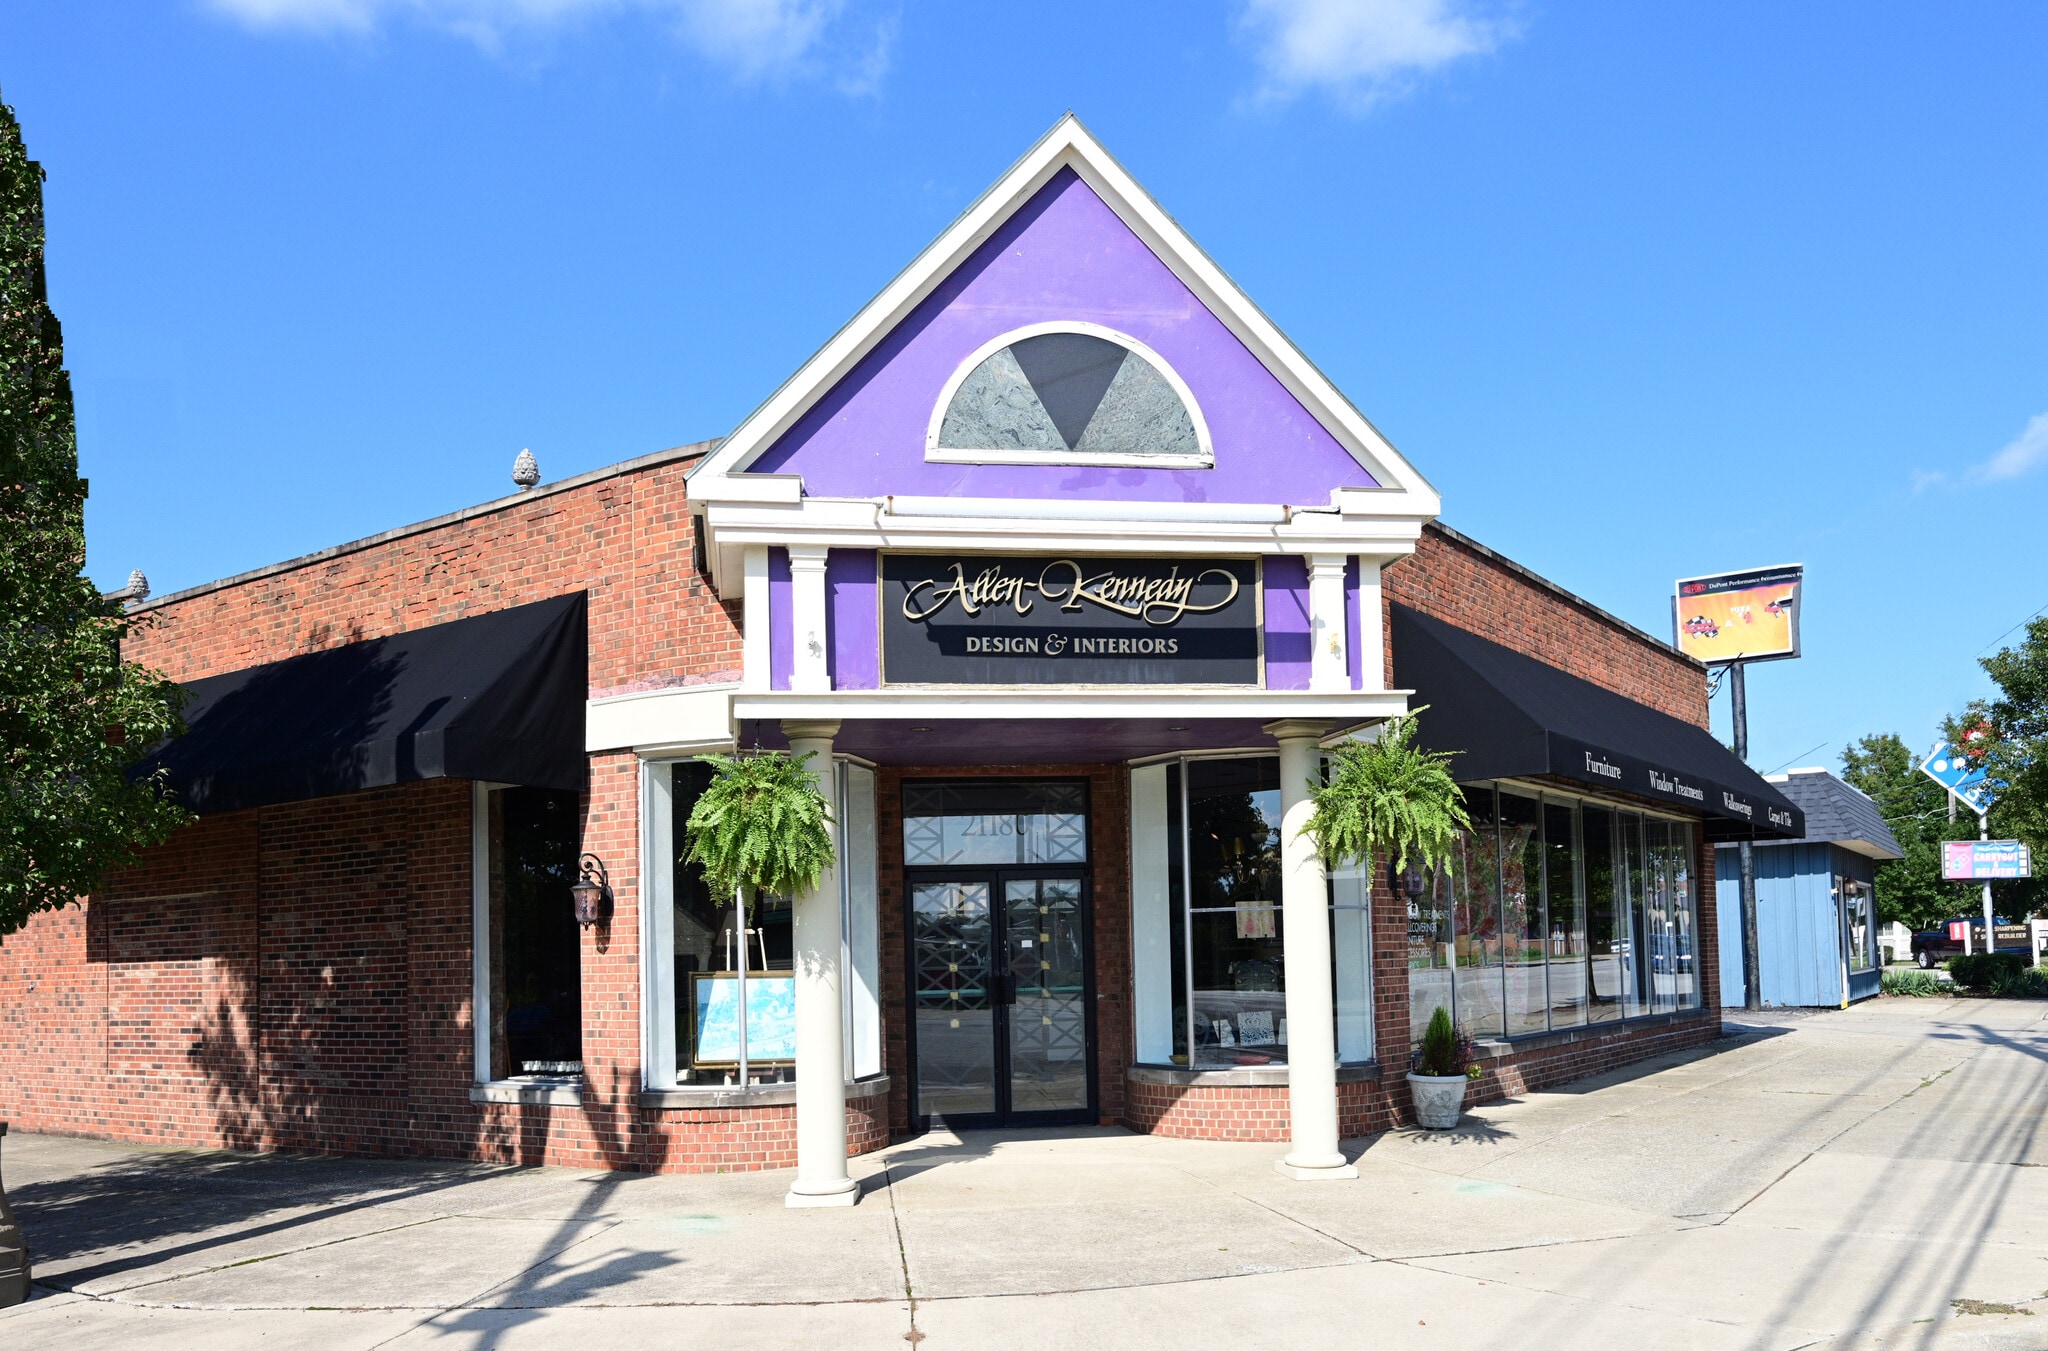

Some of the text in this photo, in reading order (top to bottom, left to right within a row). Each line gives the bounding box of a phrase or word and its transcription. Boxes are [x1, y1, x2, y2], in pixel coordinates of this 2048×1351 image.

[966, 633, 1179, 656] DESIGN & INTERIORS
[1585, 751, 1622, 779] Furniture
[1649, 769, 1674, 793] Window
[1674, 777, 1704, 801] Treatments
[1973, 852, 2019, 863] CARRYOUT
[1975, 867, 2017, 877] DELIVERY
[1407, 922, 1437, 933] LLCOVERINGS
[1408, 935, 1425, 946] NITURE
[1408, 947, 1431, 958] CESSORIES
